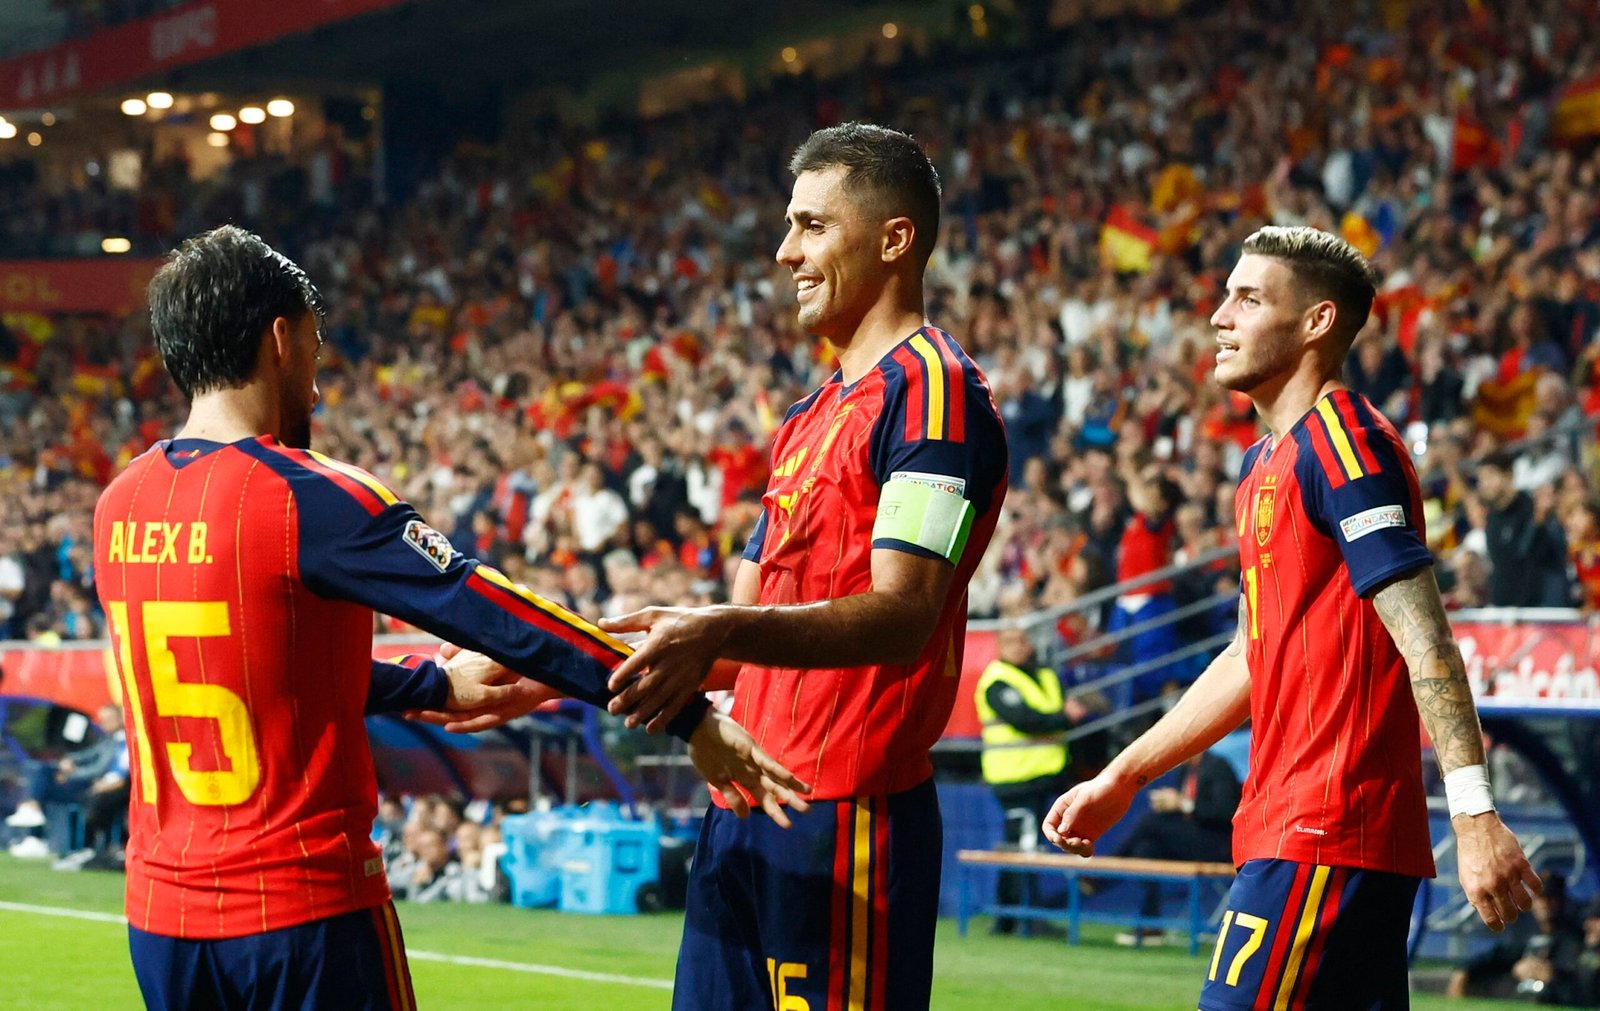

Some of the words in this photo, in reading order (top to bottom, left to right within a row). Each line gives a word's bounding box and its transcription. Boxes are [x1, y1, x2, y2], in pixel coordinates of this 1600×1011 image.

[108, 520, 182, 564] ALEX
[188, 520, 214, 564] B.
[1341, 517, 1357, 528] UEFA
[109, 600, 261, 806] 15
[1208, 910, 1269, 987] 17
